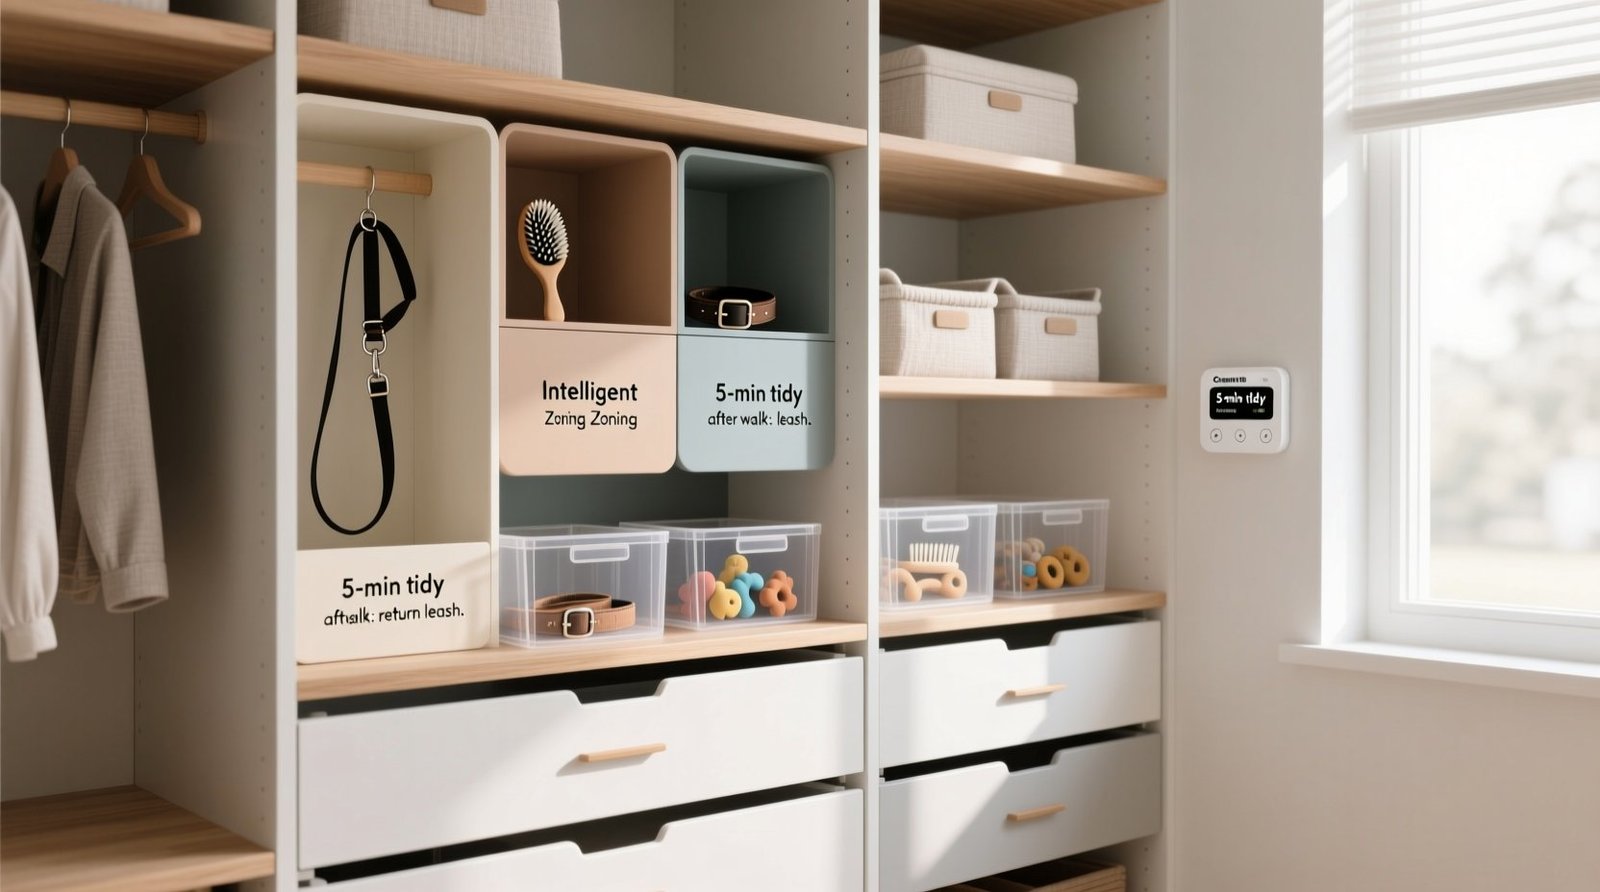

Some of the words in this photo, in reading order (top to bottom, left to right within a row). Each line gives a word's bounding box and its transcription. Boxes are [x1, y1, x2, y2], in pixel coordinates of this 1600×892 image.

[542, 379, 638, 406] Intelligent
[715, 382, 766, 403] 5-min
[770, 383, 803, 409] tidy
[590, 410, 638, 430] Zoning
[707, 410, 738, 426] after
[741, 410, 773, 426] walk:
[777, 410, 812, 426] leash.
[342, 575, 401, 599] 5-min
[406, 573, 445, 599] tidy
[379, 606, 421, 622] return
[425, 602, 465, 619] leash.
